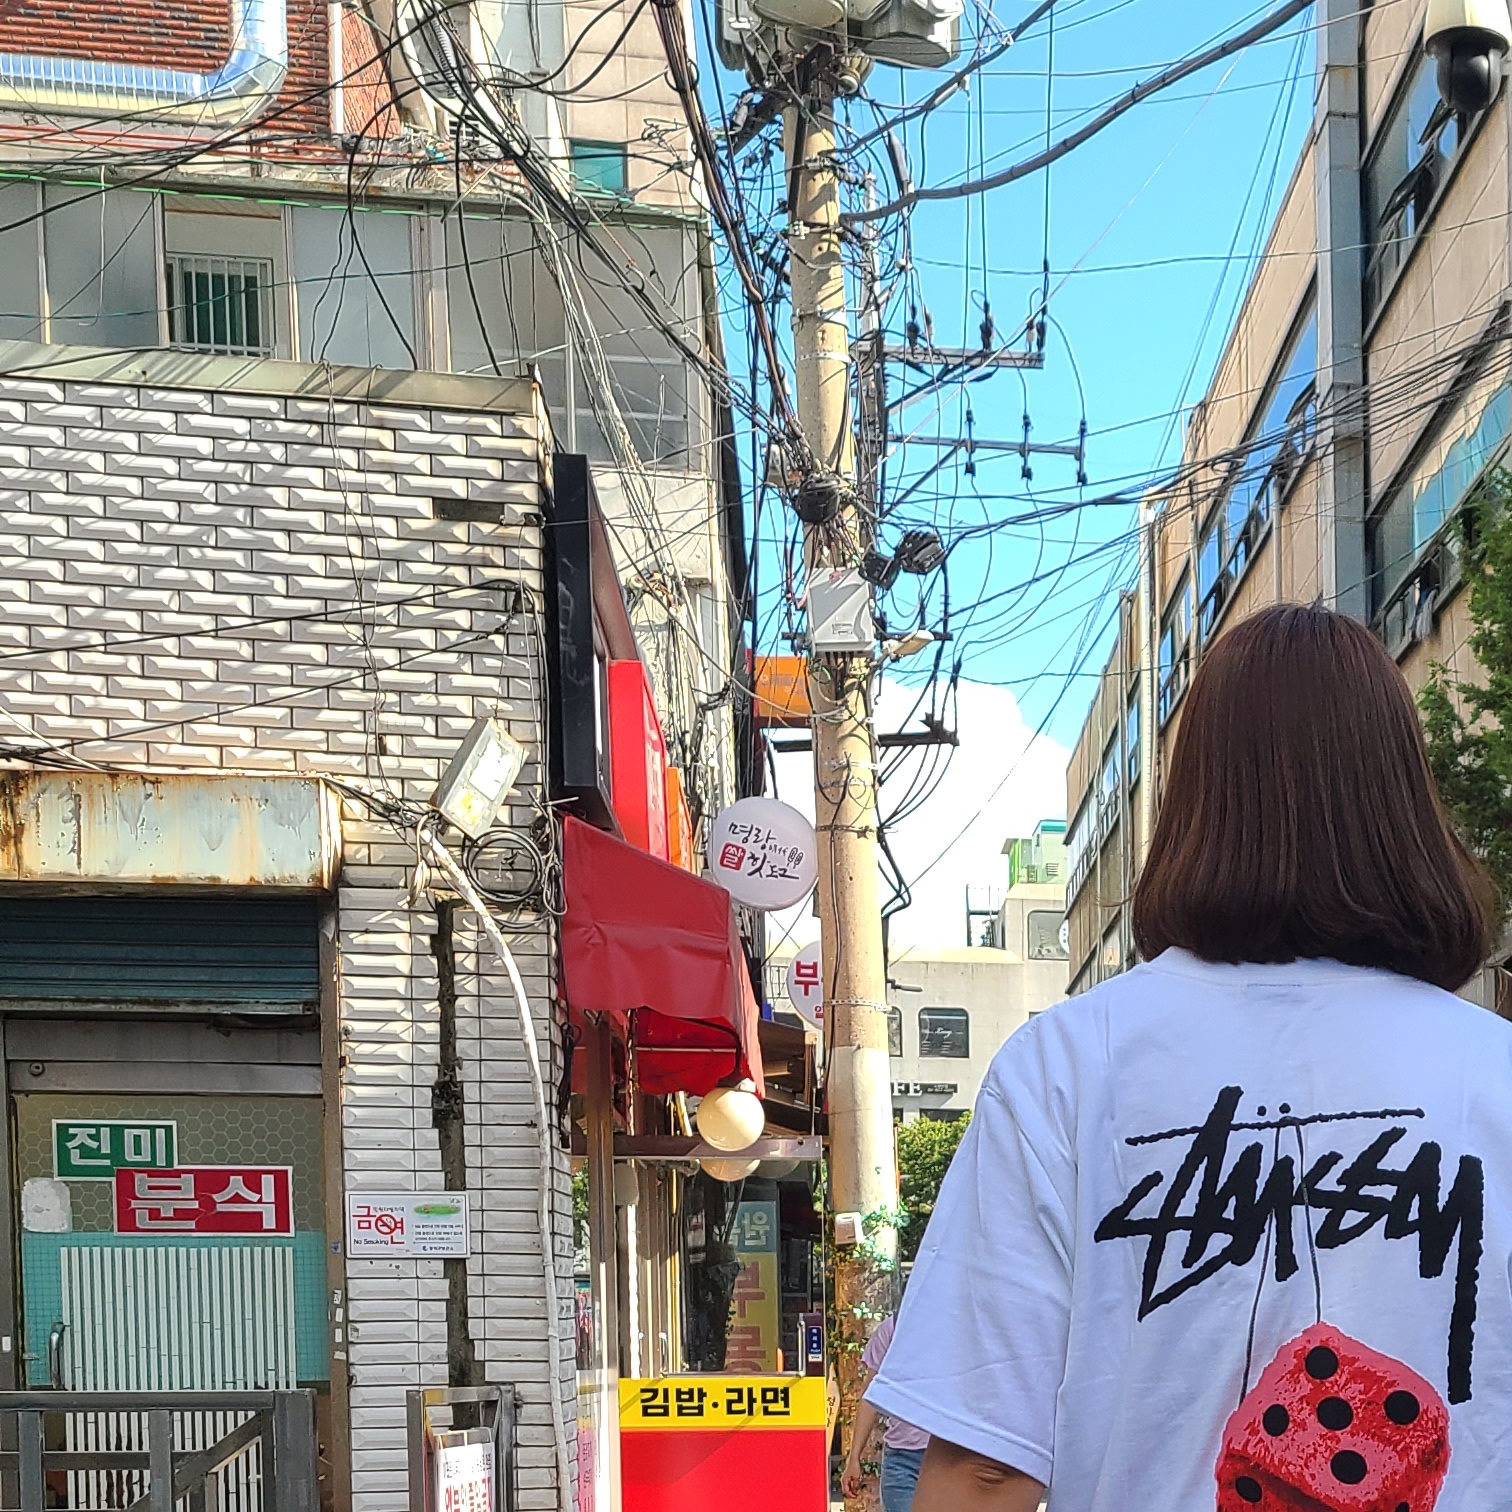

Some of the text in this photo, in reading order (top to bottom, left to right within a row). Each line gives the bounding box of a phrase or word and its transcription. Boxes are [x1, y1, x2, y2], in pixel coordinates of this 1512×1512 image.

[892, 1080, 922, 1096] FE
[65, 1127, 167, 1167] 진미
[130, 1172, 277, 1230] 분식
[352, 1205, 405, 1245] 금연
